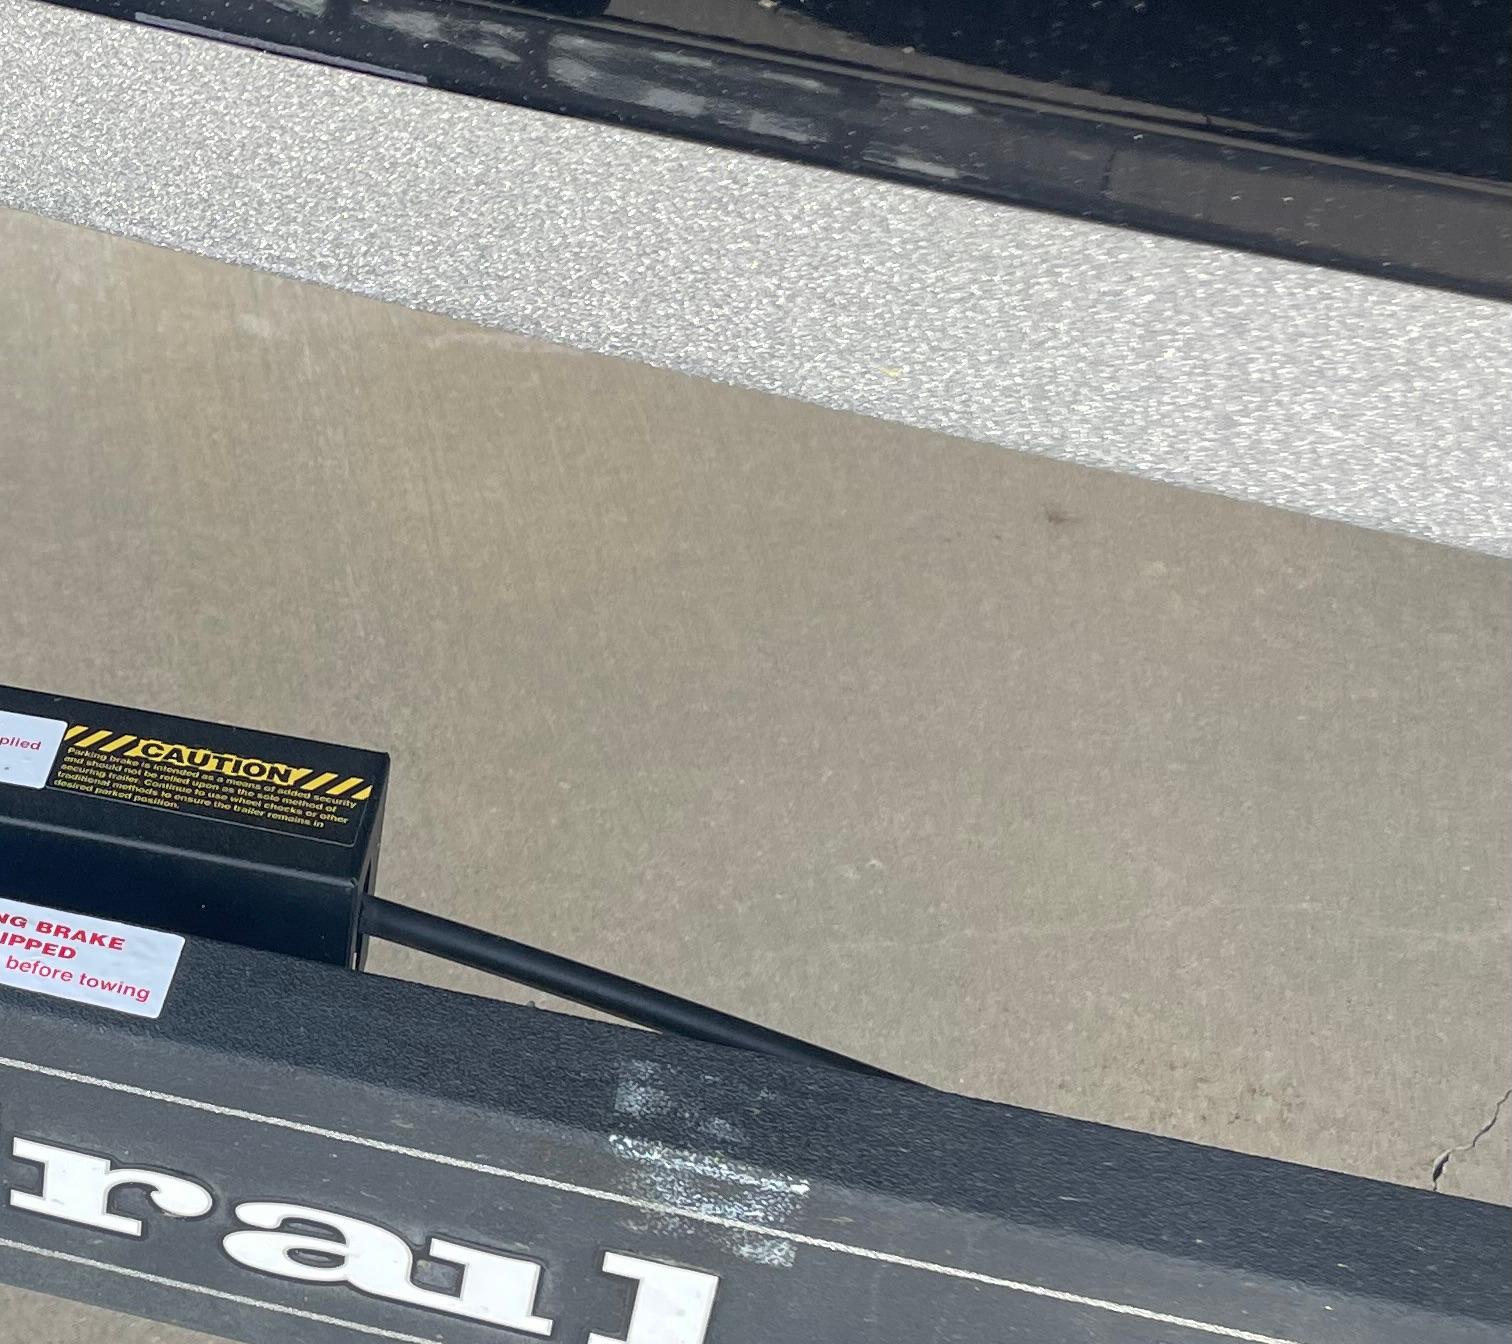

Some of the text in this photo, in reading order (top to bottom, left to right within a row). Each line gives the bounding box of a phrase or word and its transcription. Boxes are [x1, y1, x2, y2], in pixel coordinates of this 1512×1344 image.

[53, 779, 94, 792] desired
[94, 786, 132, 800] parked
[64, 756, 337, 813] and should not be relied upon as the sole method of
[67, 747, 107, 762] Parking
[110, 754, 139, 767] brake
[141, 761, 151, 769] is
[154, 763, 200, 778] intended
[201, 770, 214, 780] as
[226, 779, 262, 791] means
[264, 784, 276, 792] of
[278, 787, 312, 799] added
[314, 794, 357, 809] security
[140, 742, 293, 784] CAUTION
[57, 771, 325, 828] traditional methods to ensure the trailer remains in
[60, 764, 106, 779] securing
[144, 778, 192, 794] Continue
[194, 788, 206, 797] to
[208, 792, 228, 801] use
[230, 796, 262, 808] wheel
[305, 810, 317, 818] or
[319, 812, 349, 825] other
[34, 921, 125, 951] BRAKE
[6, 955, 73, 983] before
[79, 972, 151, 1004] towing
